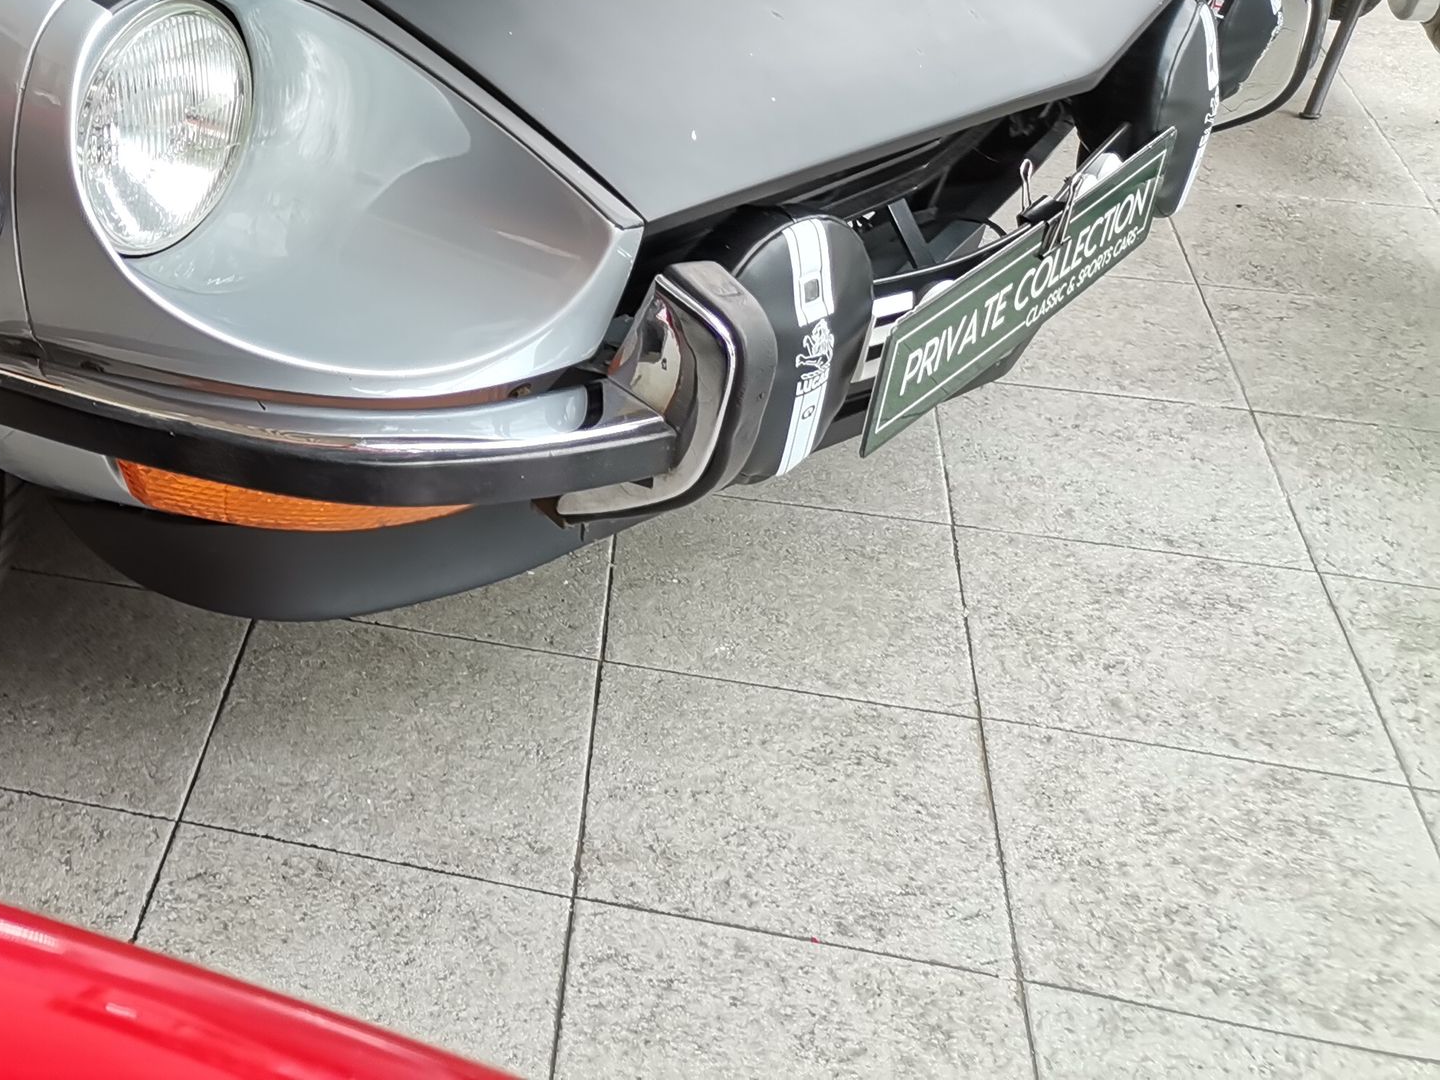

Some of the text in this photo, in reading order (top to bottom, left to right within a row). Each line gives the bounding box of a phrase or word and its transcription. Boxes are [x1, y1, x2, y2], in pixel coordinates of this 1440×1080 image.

[898, 182, 1151, 397] PRIVATE COLLECTION
[1024, 228, 1139, 329] CLASSIC & SPORTS CARS
